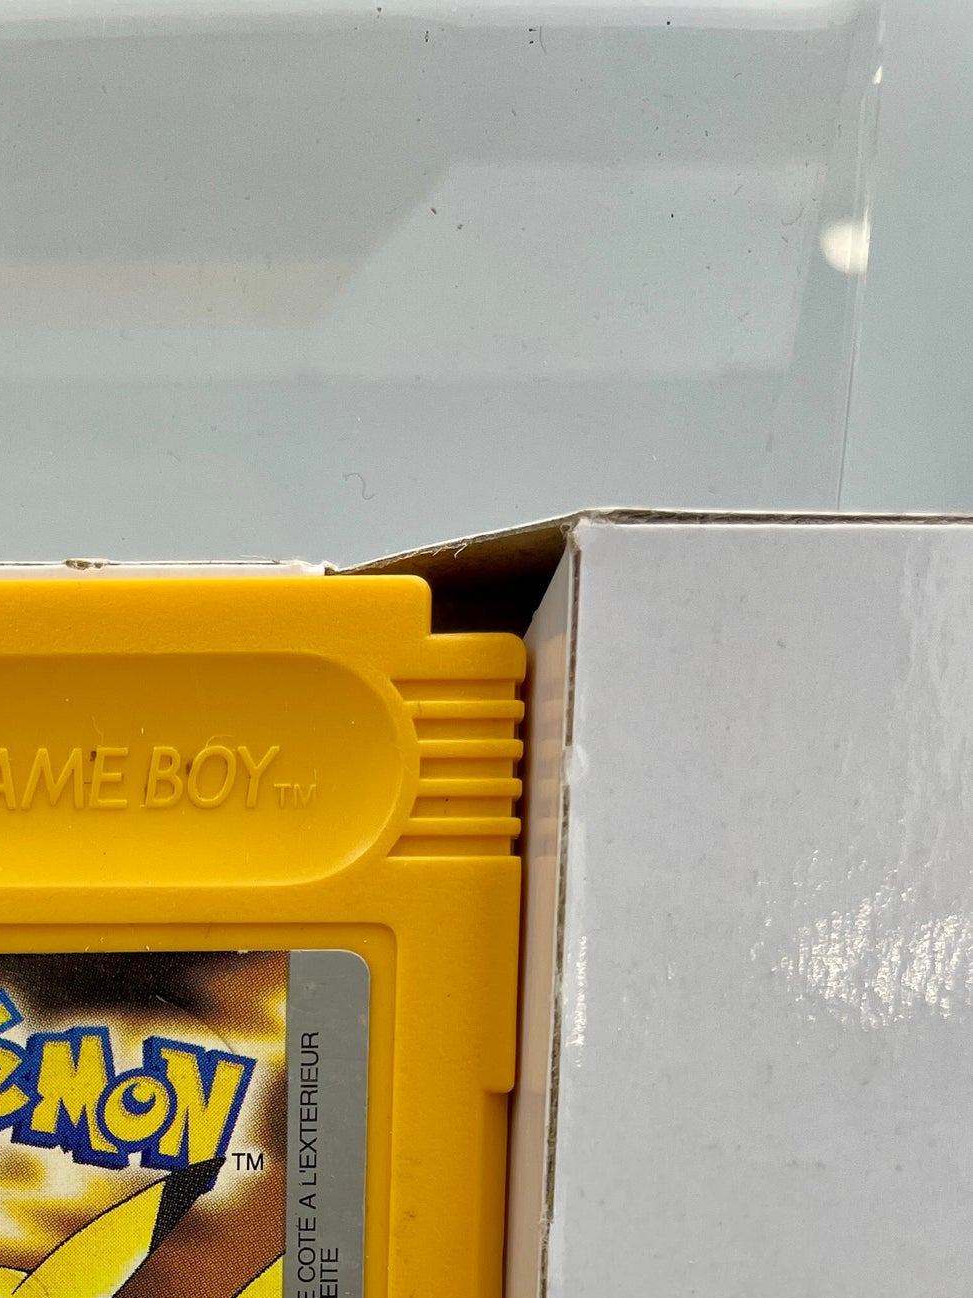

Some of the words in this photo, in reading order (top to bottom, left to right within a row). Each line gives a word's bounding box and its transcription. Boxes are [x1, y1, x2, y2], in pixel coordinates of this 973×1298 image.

[146, 745, 280, 810] BOY
[299, 1031, 319, 1186] L'EXTERIEUR
[232, 1153, 265, 1171] TM
[298, 1193, 317, 1210] A
